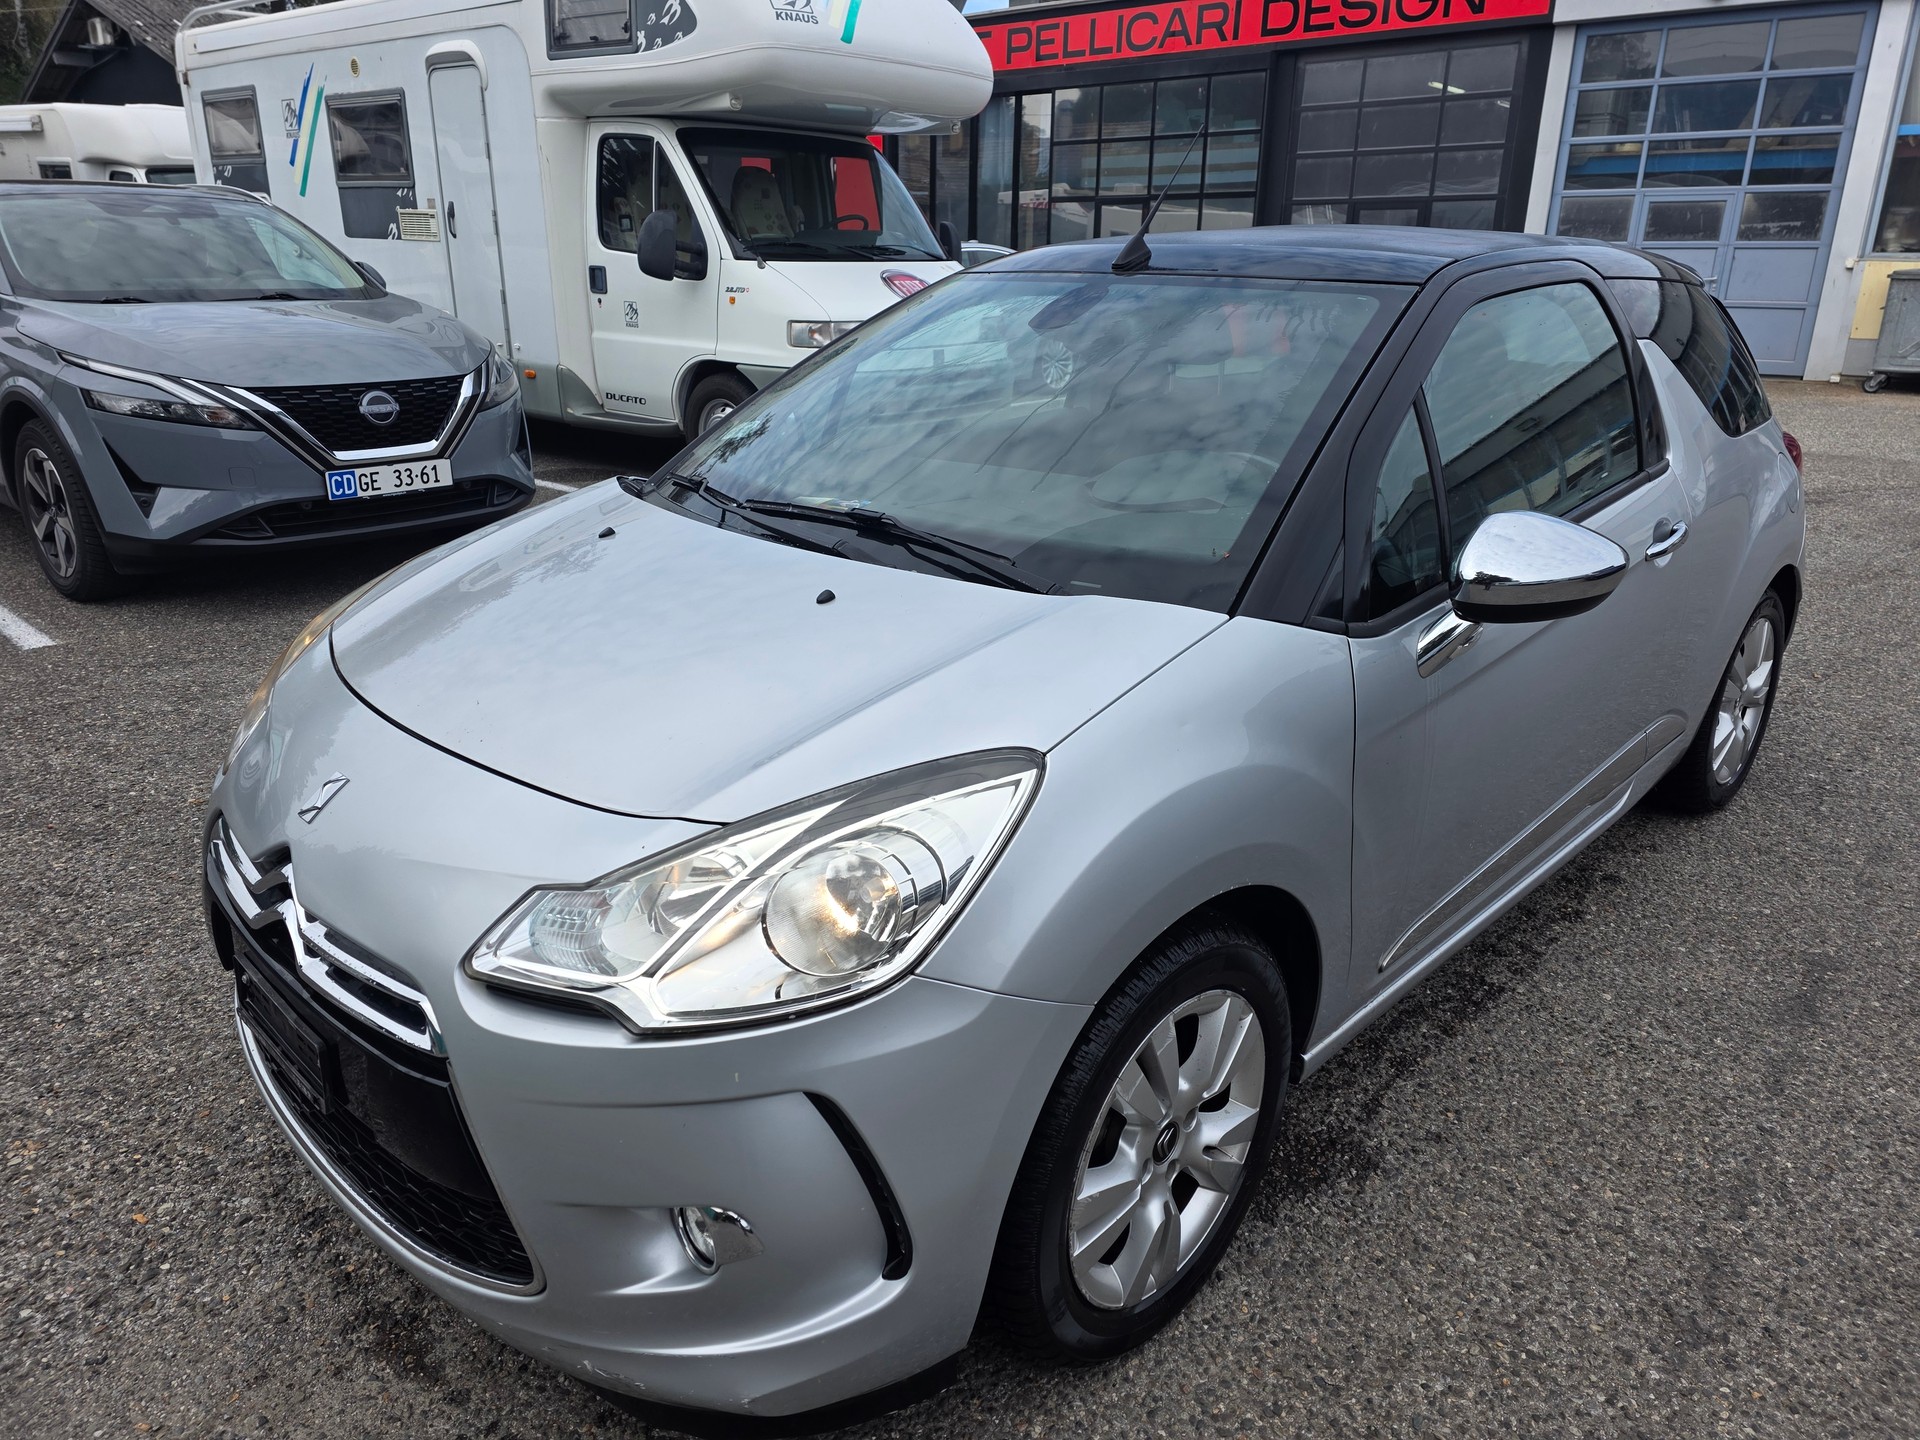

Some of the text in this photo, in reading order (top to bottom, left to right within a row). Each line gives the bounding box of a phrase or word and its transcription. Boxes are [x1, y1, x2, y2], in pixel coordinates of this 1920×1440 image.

[775, 11, 819, 24] KNAUS
[1006, 0, 1243, 64] PELLICARI
[605, 392, 647, 405] DUCATO
[359, 403, 400, 414] NISSAN
[331, 474, 356, 496] CD
[358, 471, 382, 492] GE
